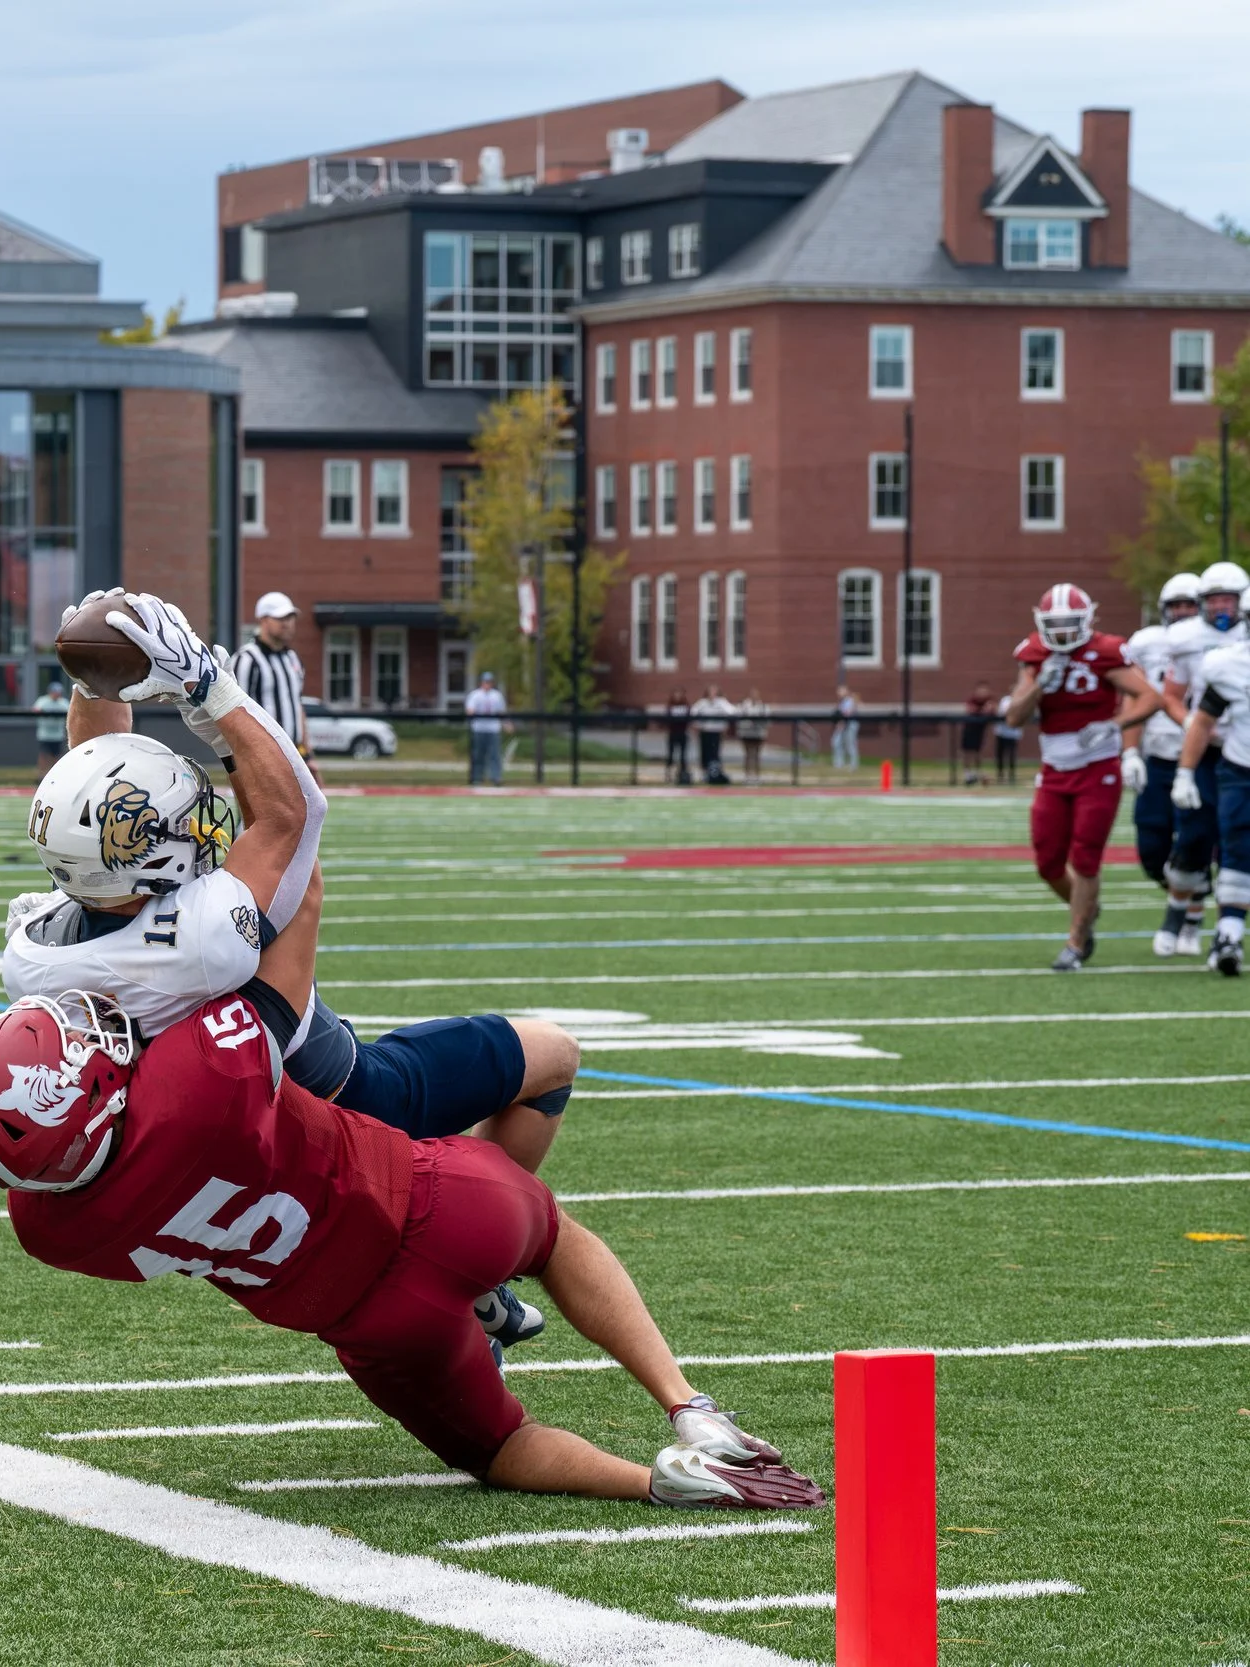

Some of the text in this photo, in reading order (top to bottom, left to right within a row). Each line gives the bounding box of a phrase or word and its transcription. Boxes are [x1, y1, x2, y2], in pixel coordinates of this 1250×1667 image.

[29, 799, 54, 847] 11
[142, 908, 182, 949] 11
[202, 1000, 261, 1051] 15
[128, 1175, 311, 1287] 15
